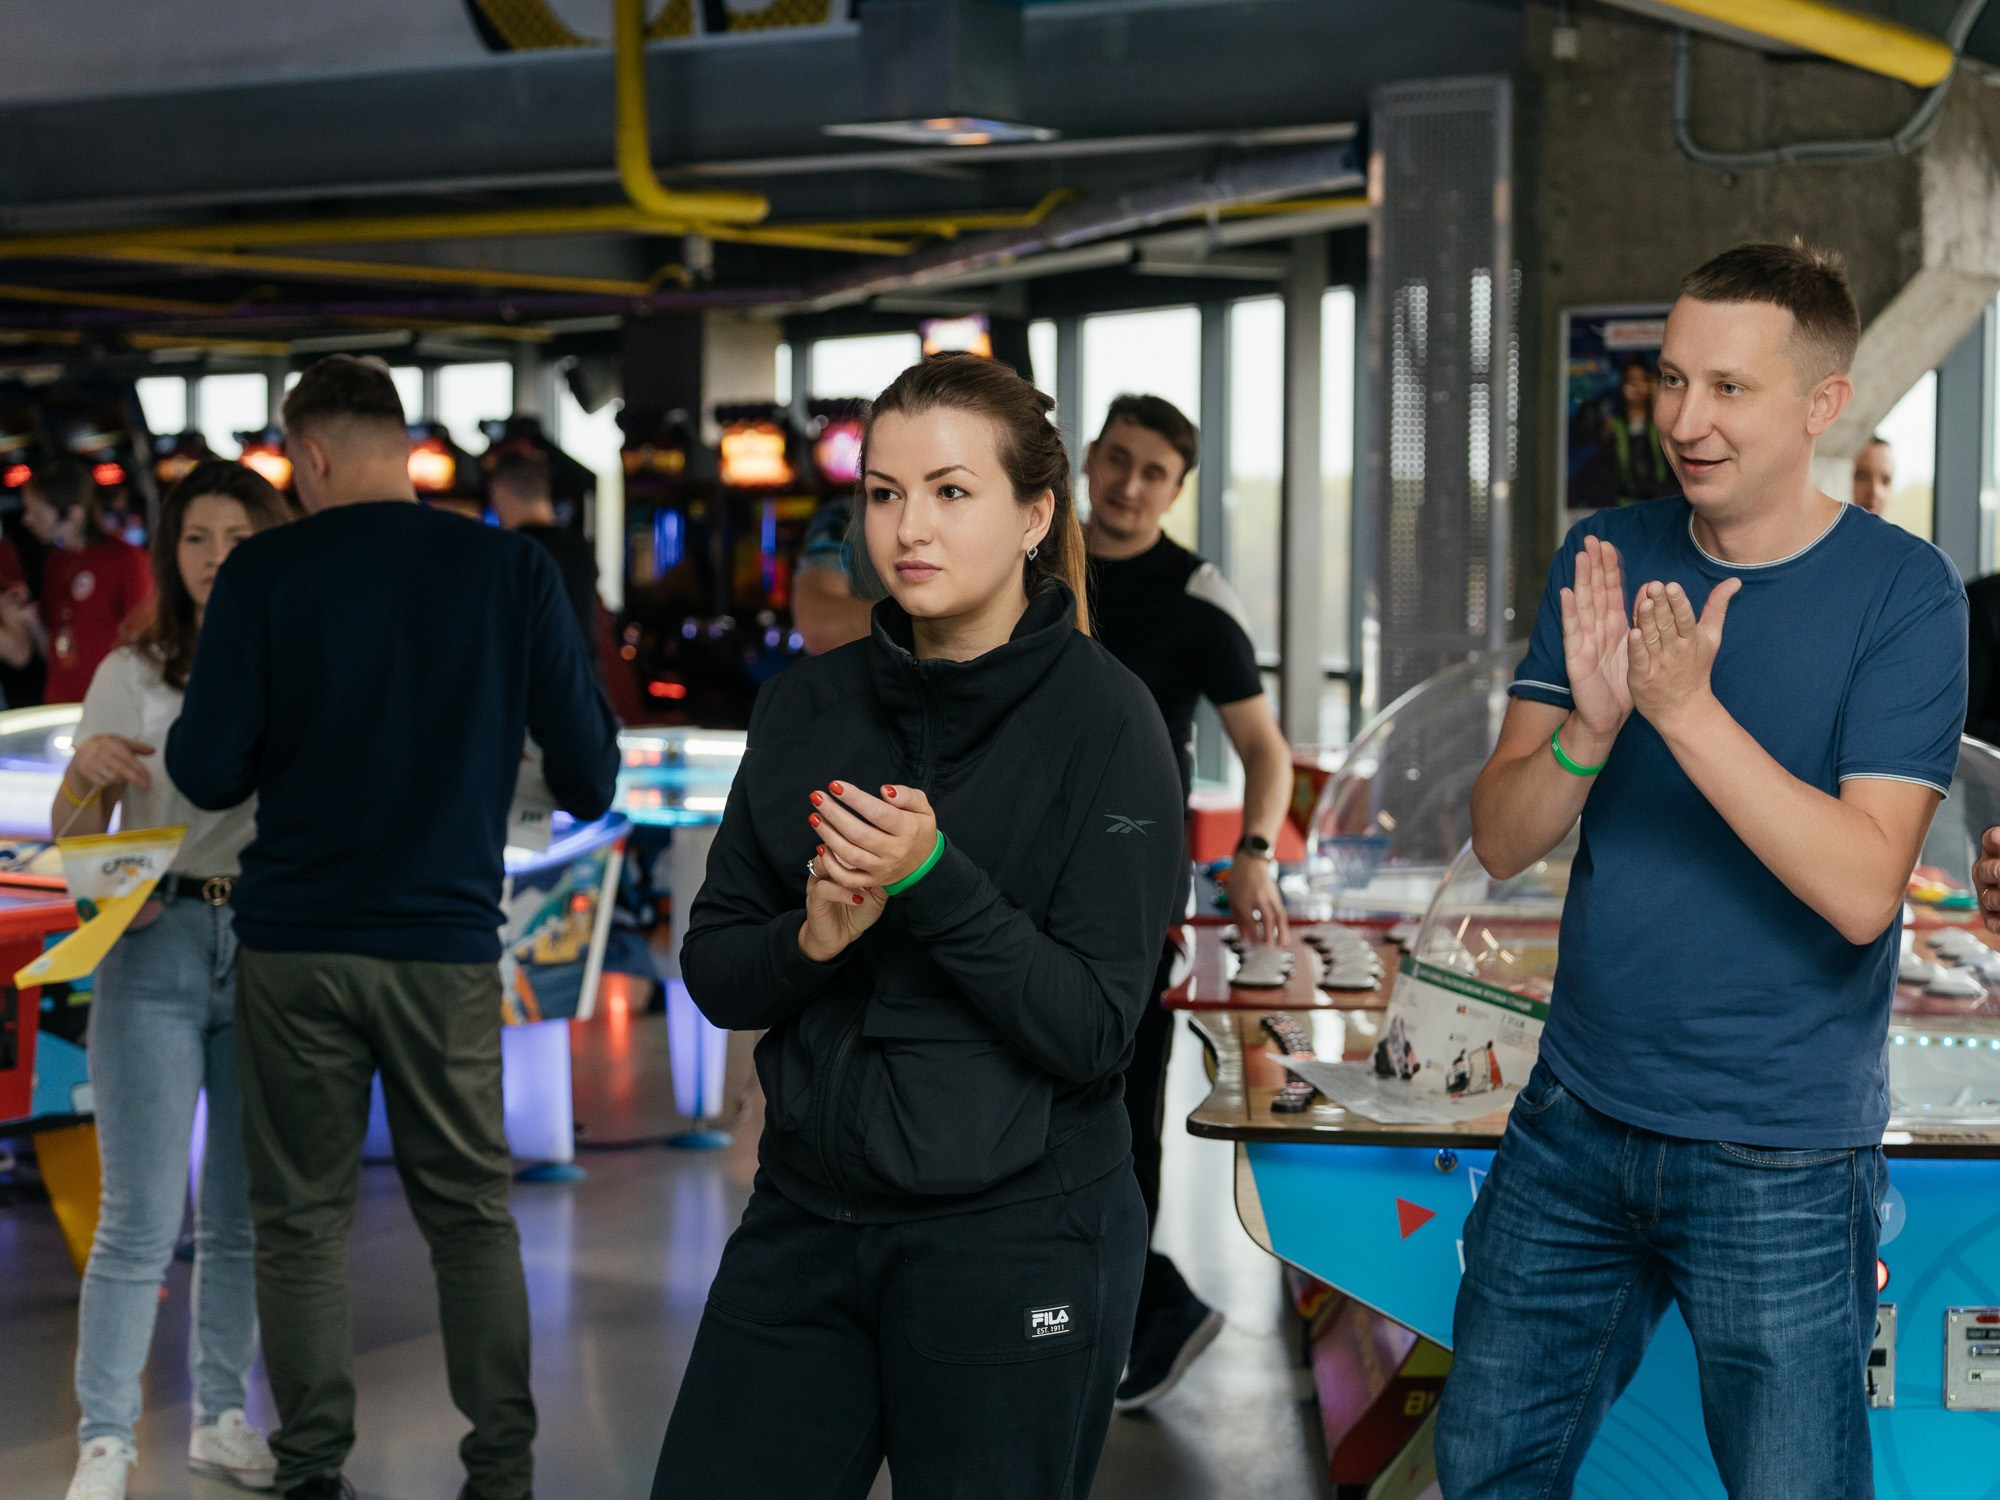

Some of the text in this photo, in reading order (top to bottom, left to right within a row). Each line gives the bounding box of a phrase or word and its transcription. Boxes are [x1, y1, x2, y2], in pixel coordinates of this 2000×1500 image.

[1031, 1309, 1069, 1328] FILA
[1036, 1324, 1065, 1335] EST. 1911
